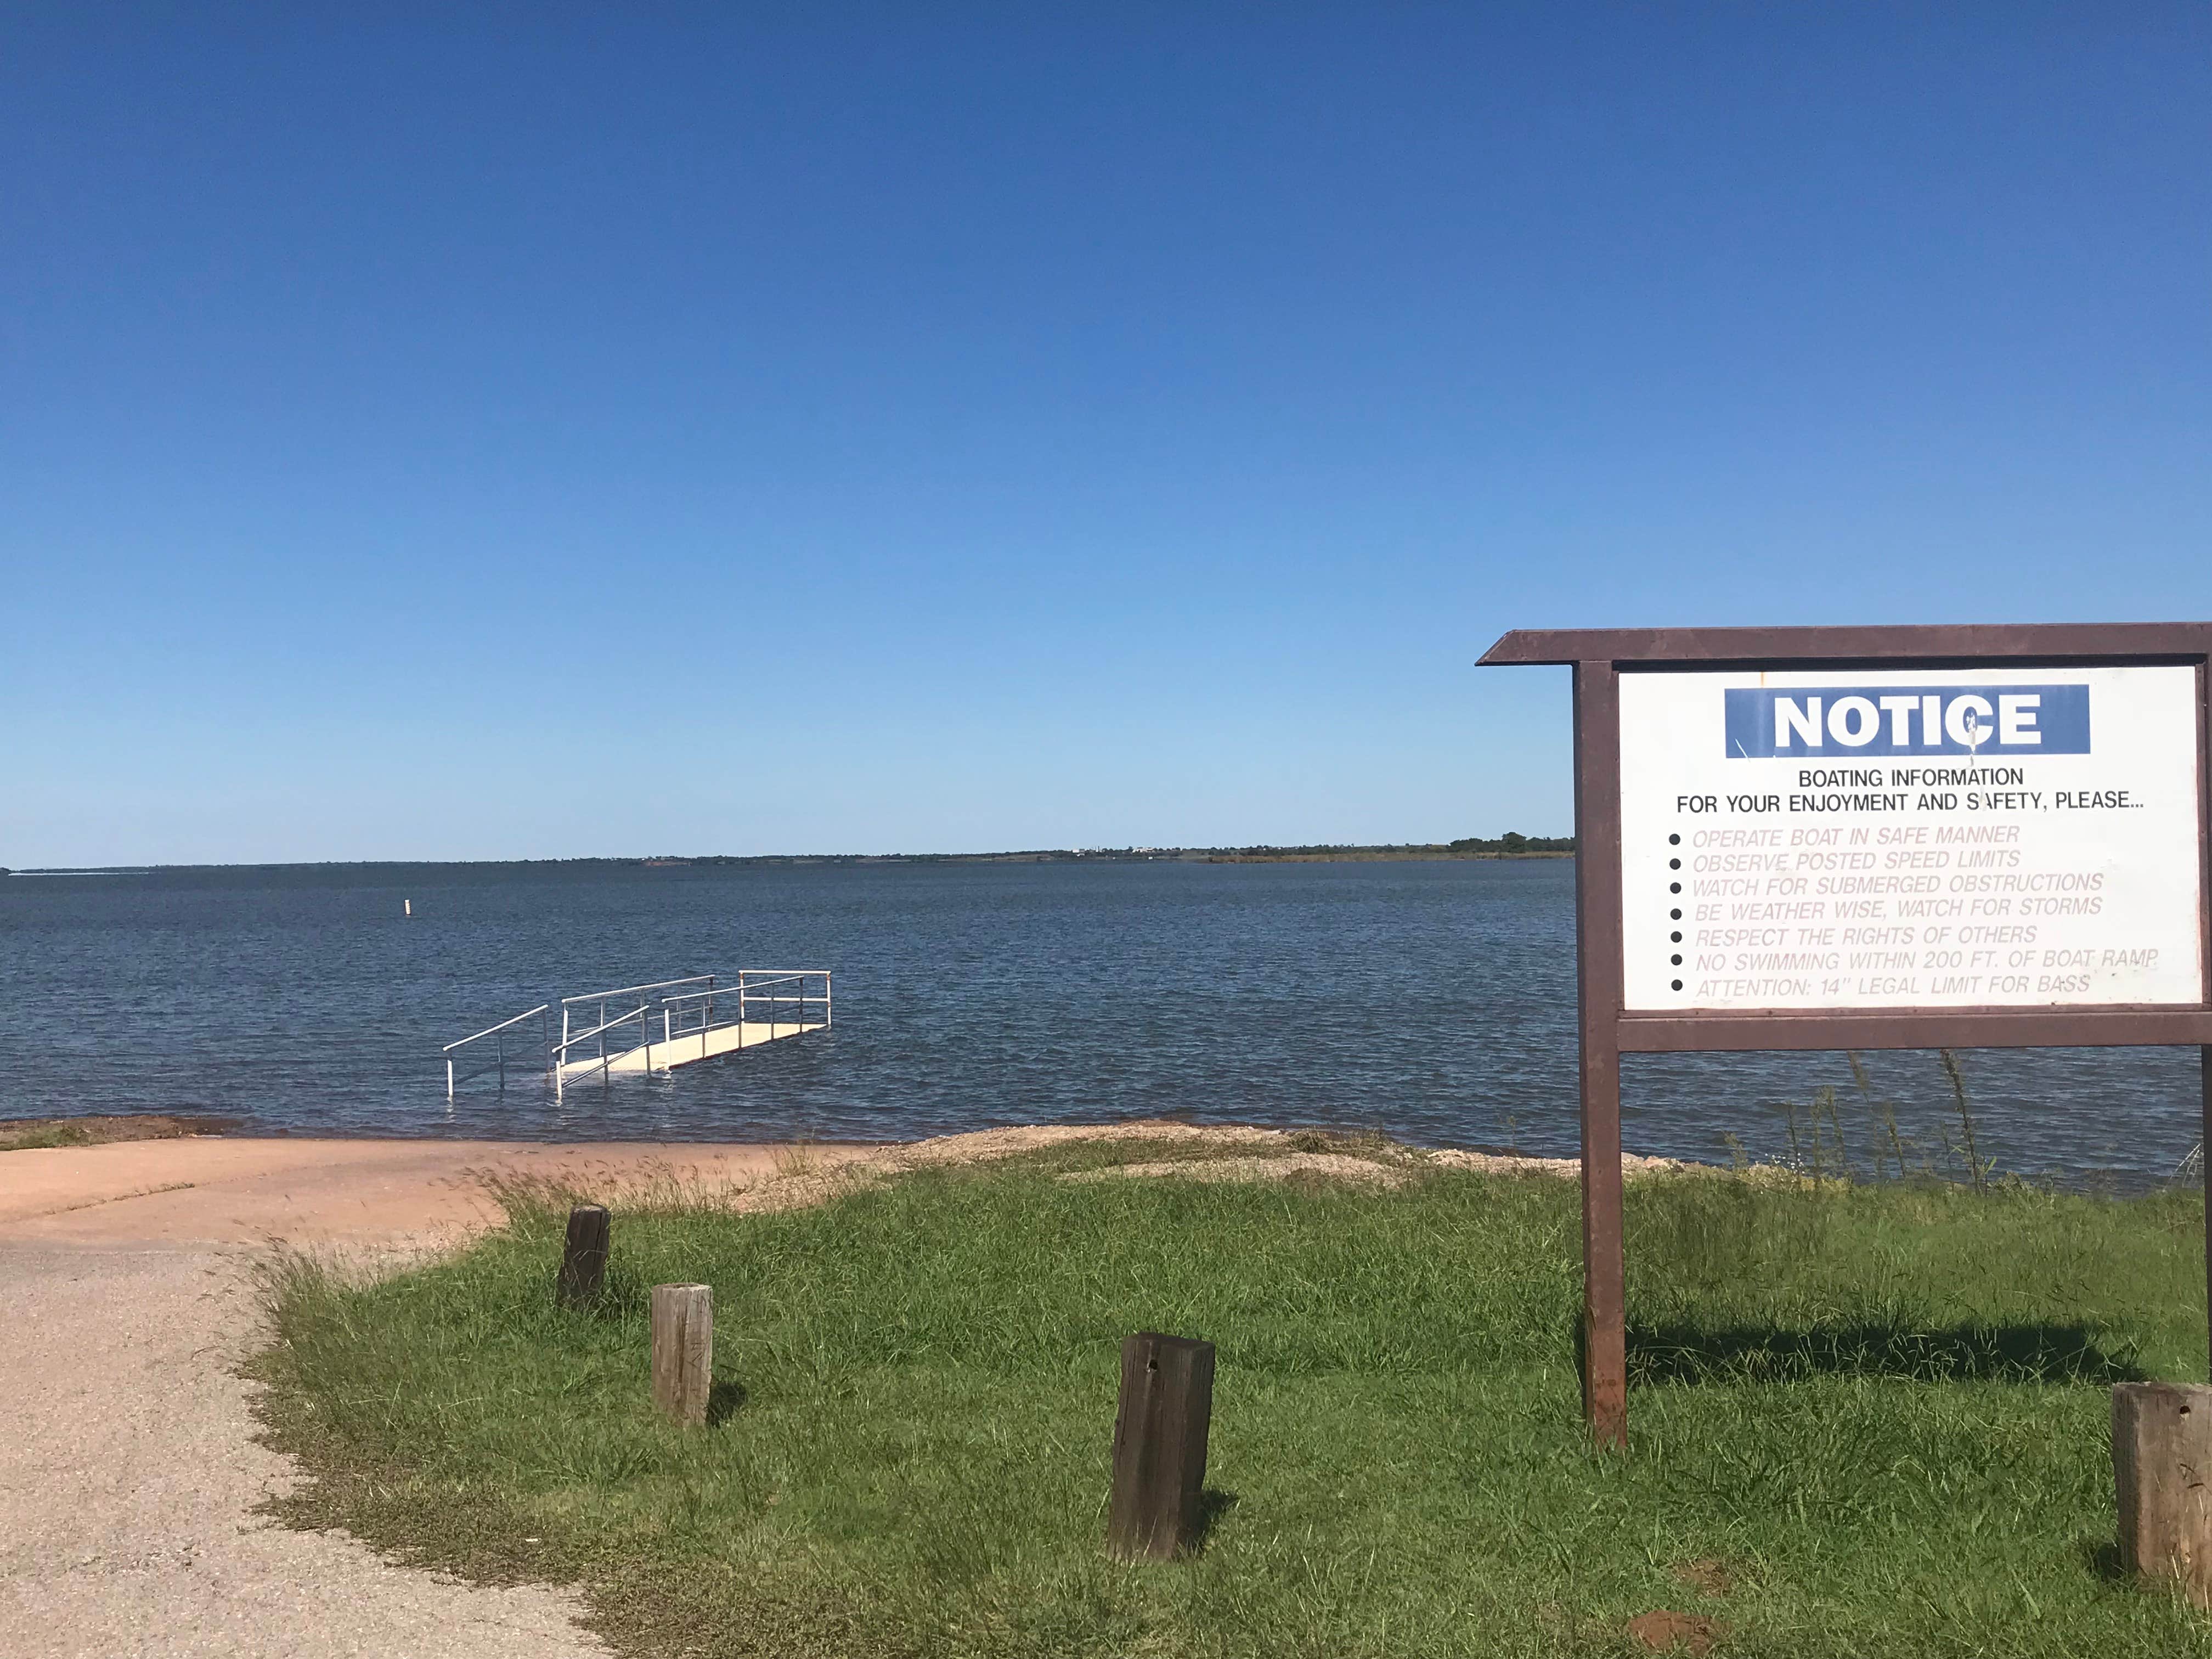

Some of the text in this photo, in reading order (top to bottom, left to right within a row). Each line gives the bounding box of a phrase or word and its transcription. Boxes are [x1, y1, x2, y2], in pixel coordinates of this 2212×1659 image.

[1775, 695, 2041, 747] NOTICE
[1799, 768, 2023, 787] BOATING INFORMATION
[1678, 795, 1717, 813] FOR
[1726, 795, 1779, 812] YOUR
[1790, 794, 1908, 811] ENJOYMENT
[1917, 793, 1957, 810] AND
[2056, 791, 2143, 808] PLEASE...
[1693, 826, 2020, 848] OPERATE BOAT IN SAFE MANNER
[1694, 850, 2021, 872] OBSERVE POSTED SPEED LIMITS
[1694, 873, 2104, 896] WATCH FOR SUBMERGED OBSTRUCTIONS
[1695, 896, 2102, 921] BE WEATHER WISE, WATCH FOR STORMS
[1696, 926, 2037, 946] RESPECT THE RIGHTS OF OTHERS
[1696, 949, 2159, 971] NO SWIMMING WITHIN 200 FT. OF BOAT RAMP
[1696, 974, 2091, 997] ATTENTION: 14" LEGAL LIMIT FOR BASS
